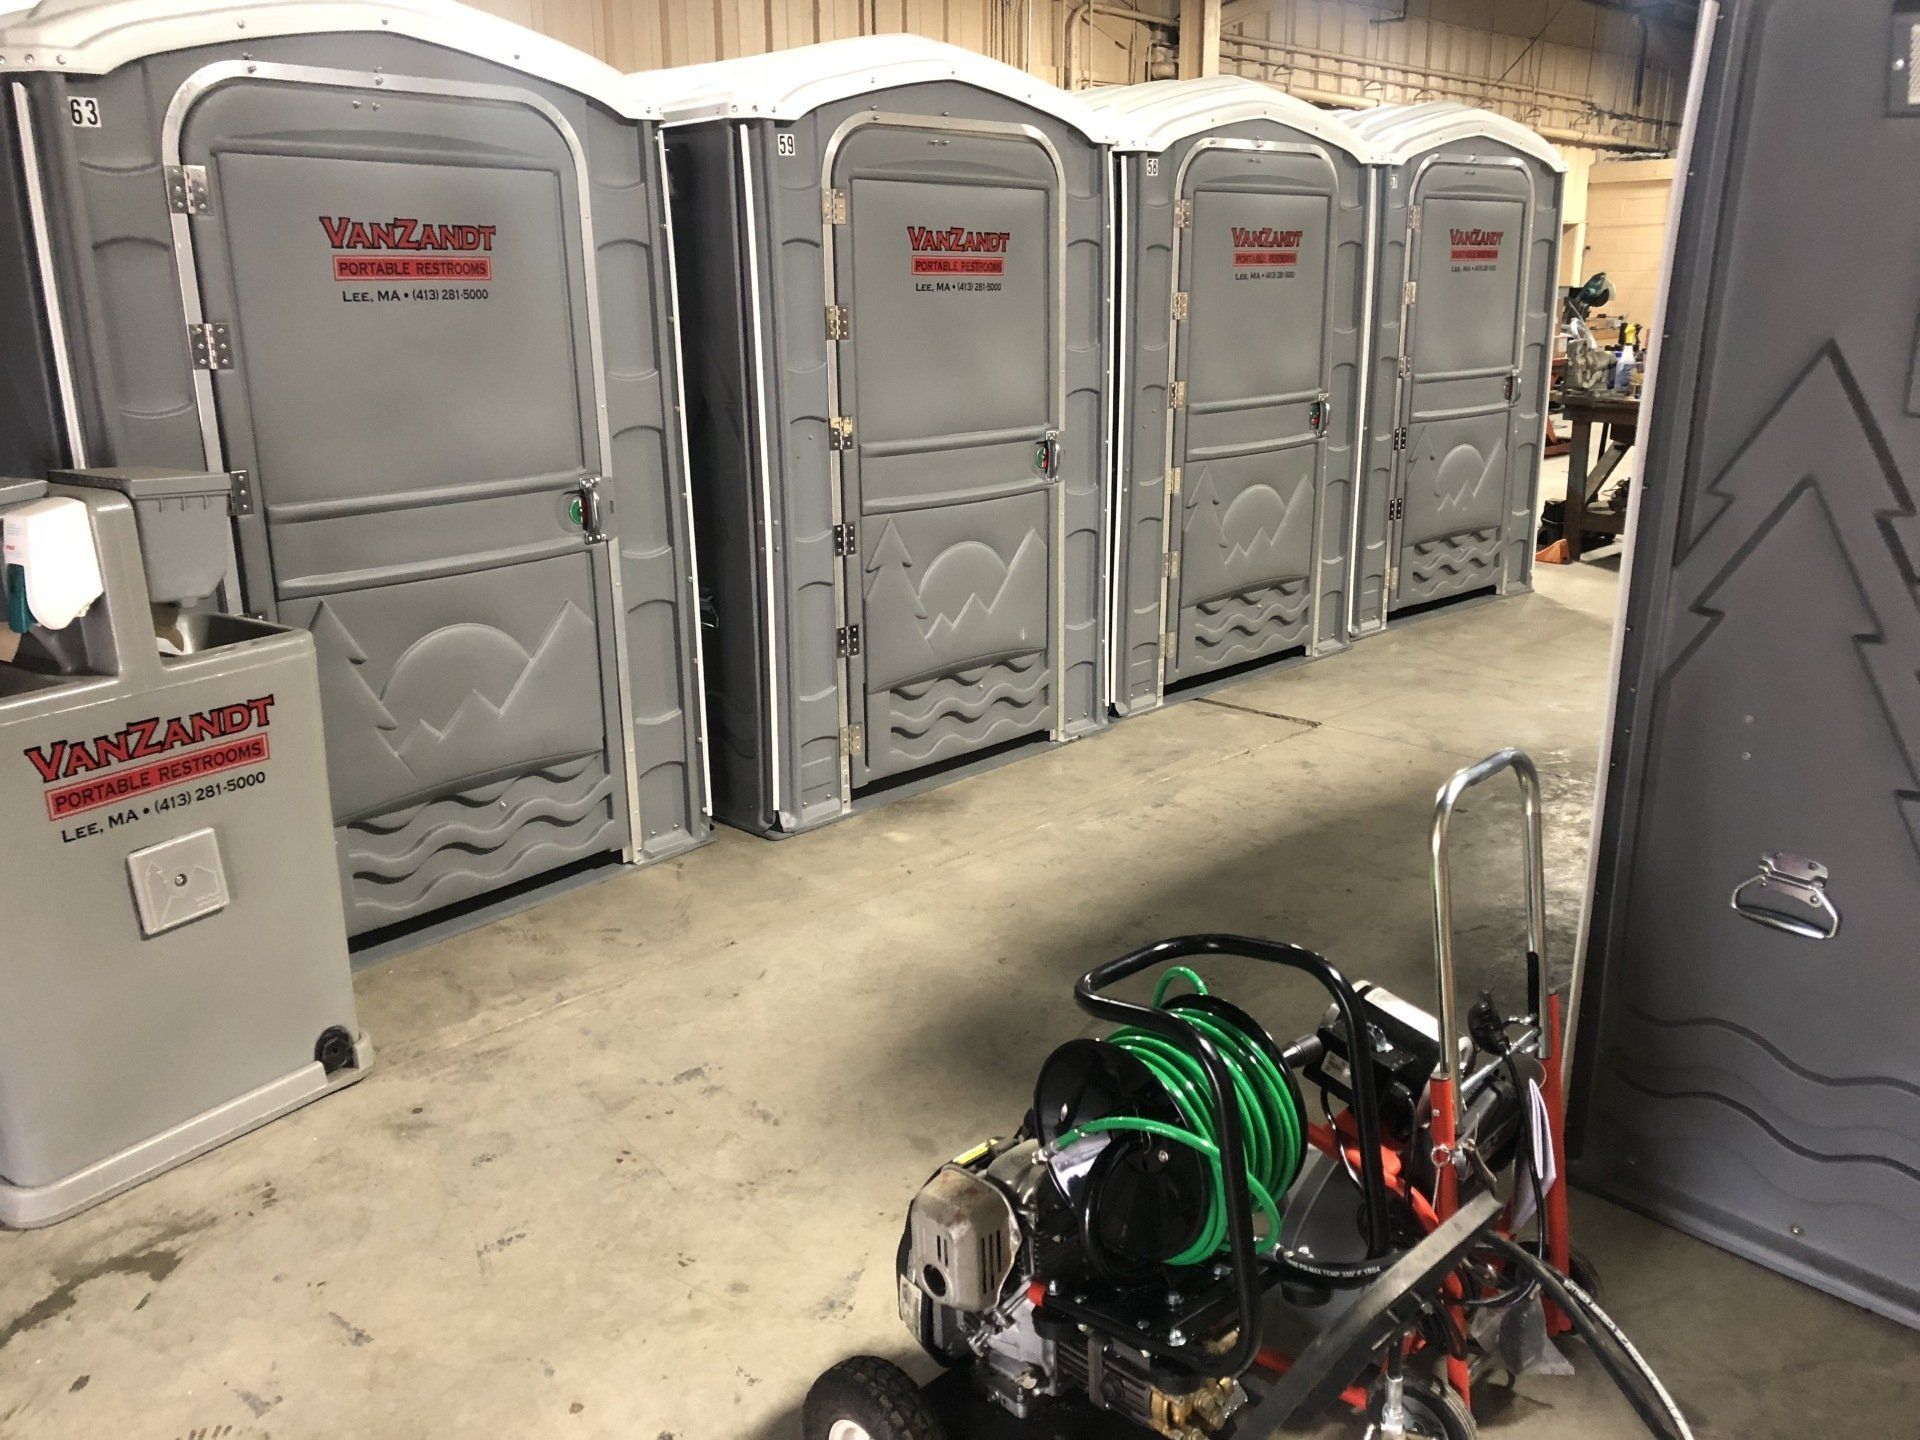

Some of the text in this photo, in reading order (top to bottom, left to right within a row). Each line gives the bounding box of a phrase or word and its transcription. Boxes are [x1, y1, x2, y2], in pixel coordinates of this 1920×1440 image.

[71, 99, 98, 125] 63
[779, 135, 794, 154] 59
[1147, 159, 1157, 175] 58
[339, 262, 486, 275] PORTABLE RESTROOMS
[915, 261, 958, 272] PORTABLE
[378, 290, 401, 301] MA
[413, 289, 439, 301] (413)
[442, 289, 488, 300] 281-5000
[937, 283, 950, 291] MA
[54, 742, 262, 812] PORTABLE RESTROOMS
[108, 809, 139, 828] MA
[154, 791, 192, 815] (413)
[196, 771, 266, 801] 281-5000
